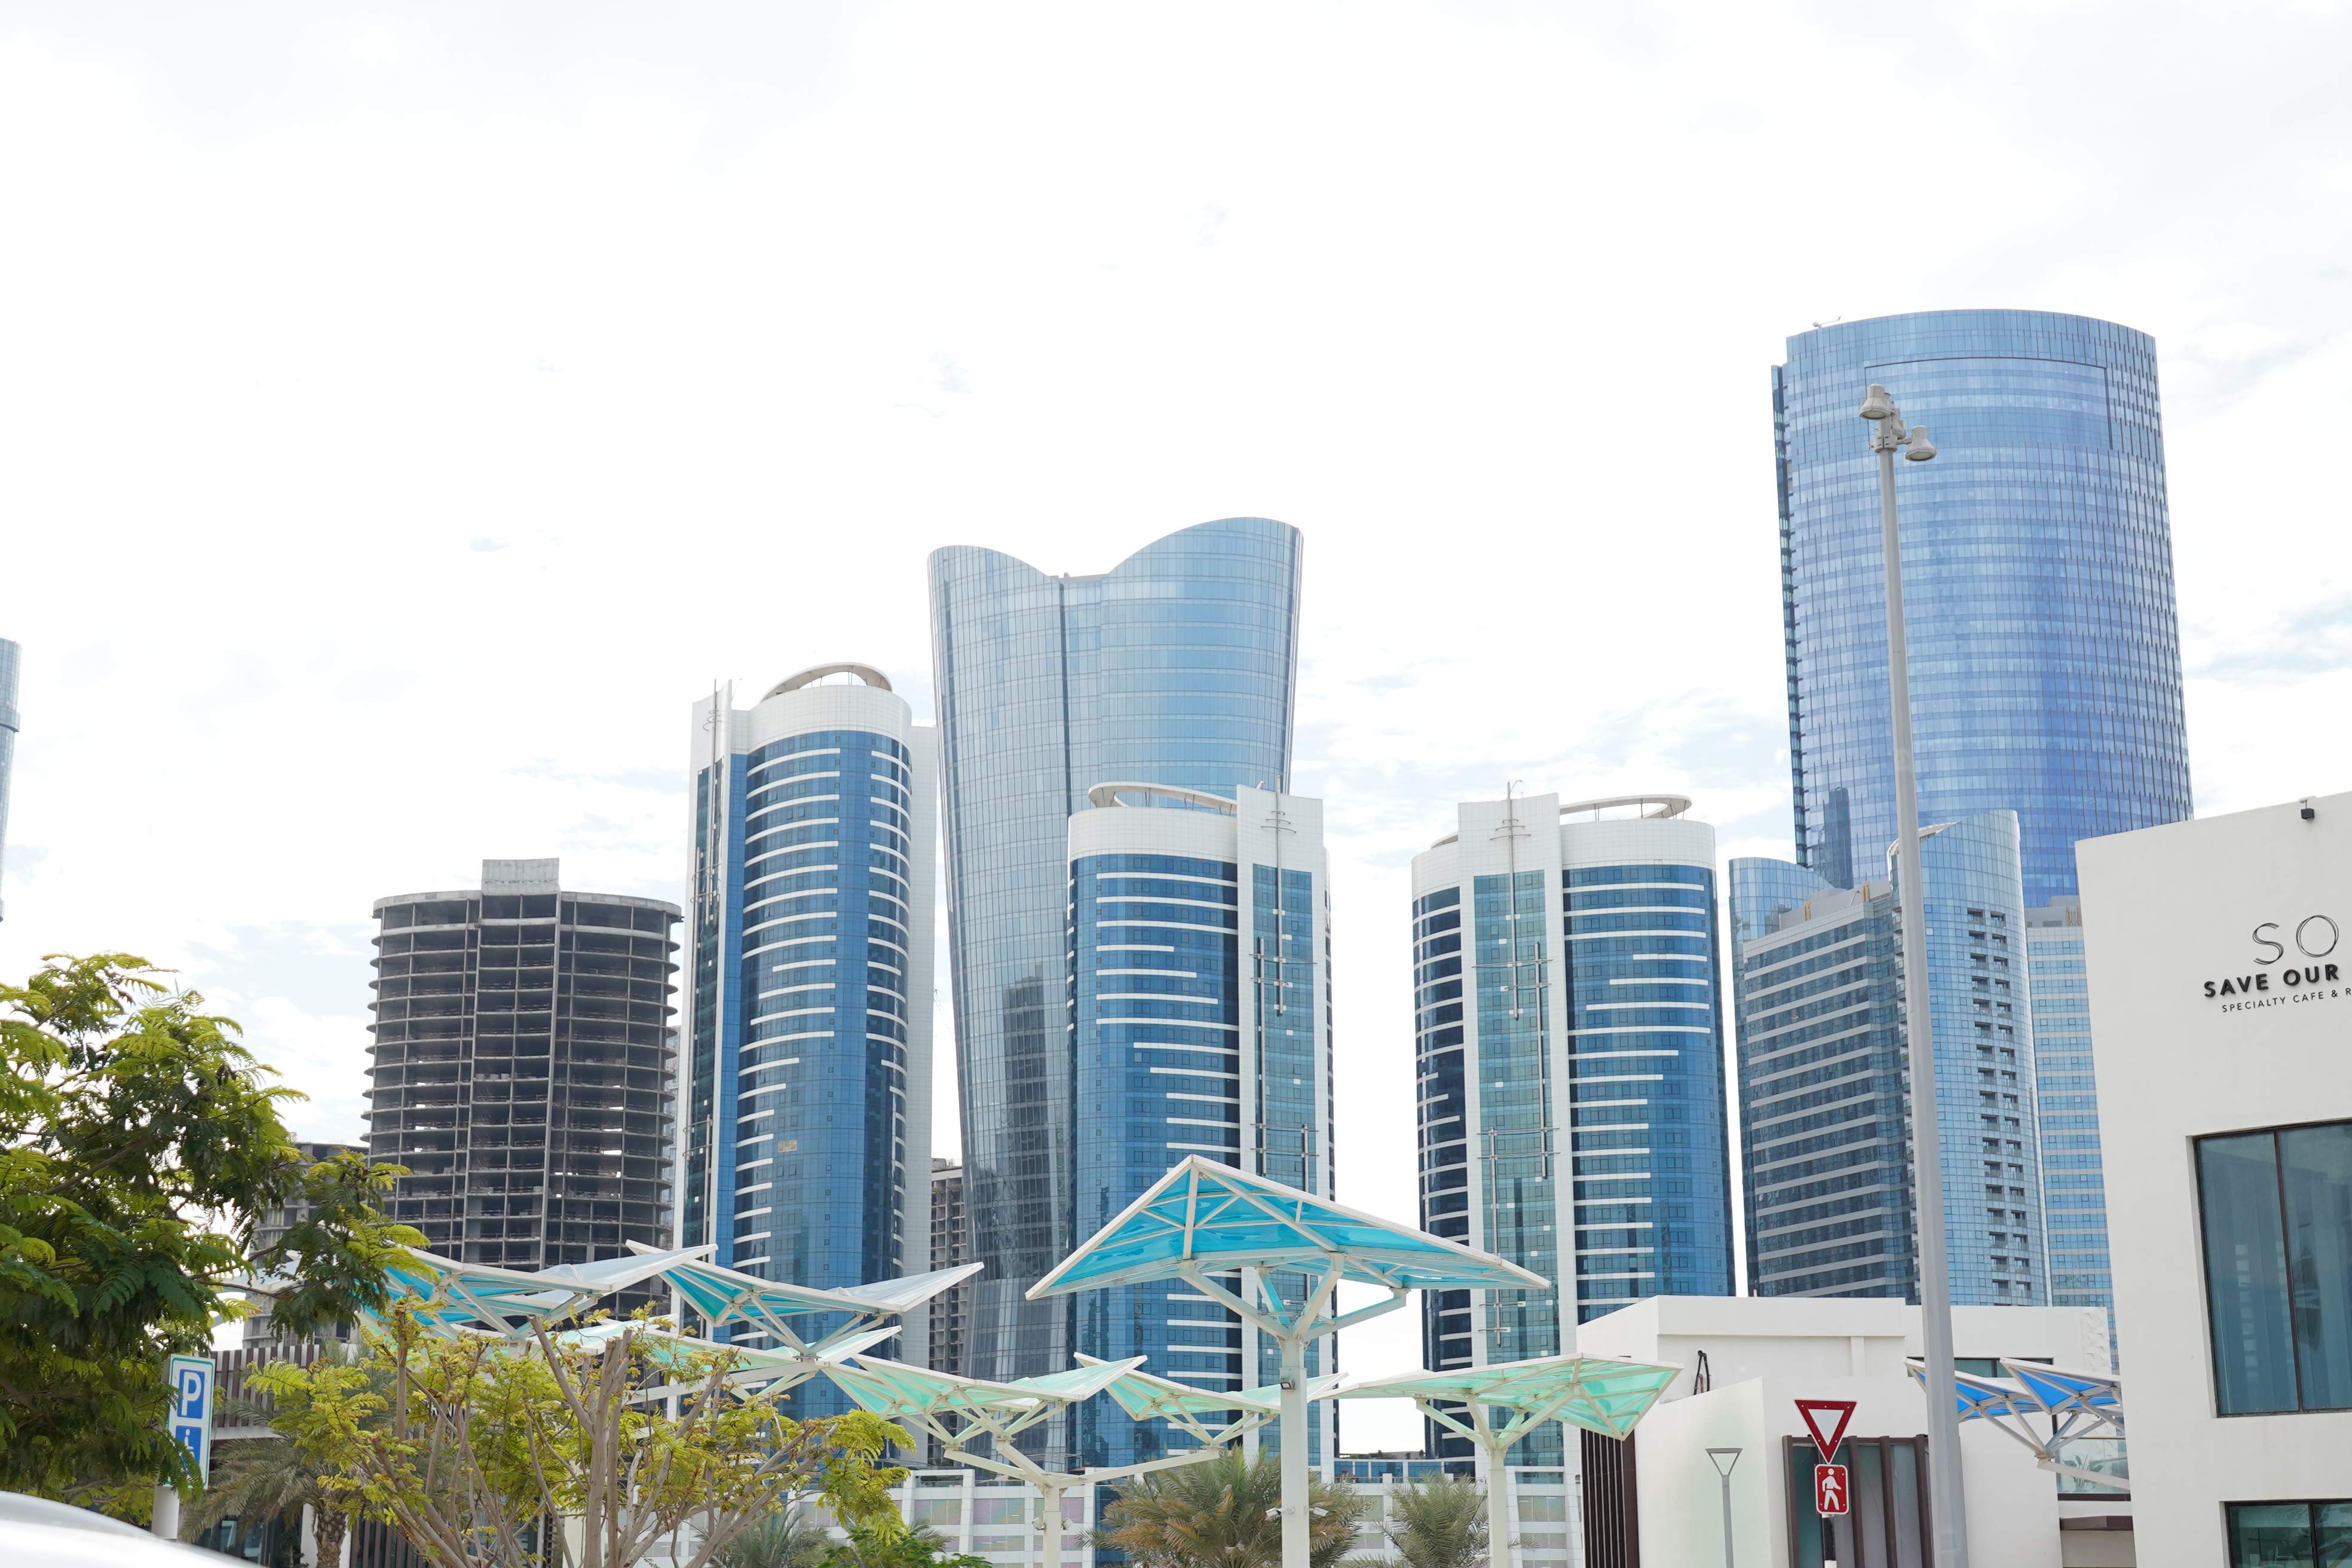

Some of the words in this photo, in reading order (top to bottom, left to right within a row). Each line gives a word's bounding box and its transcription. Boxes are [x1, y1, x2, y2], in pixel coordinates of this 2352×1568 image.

[2204, 973, 2269, 997] SAVE
[2283, 963, 2339, 986] OUR
[2222, 997, 2286, 1012] SPECIALTY
[2293, 991, 2324, 1003] CAFE
[181, 1371, 202, 1416] P
